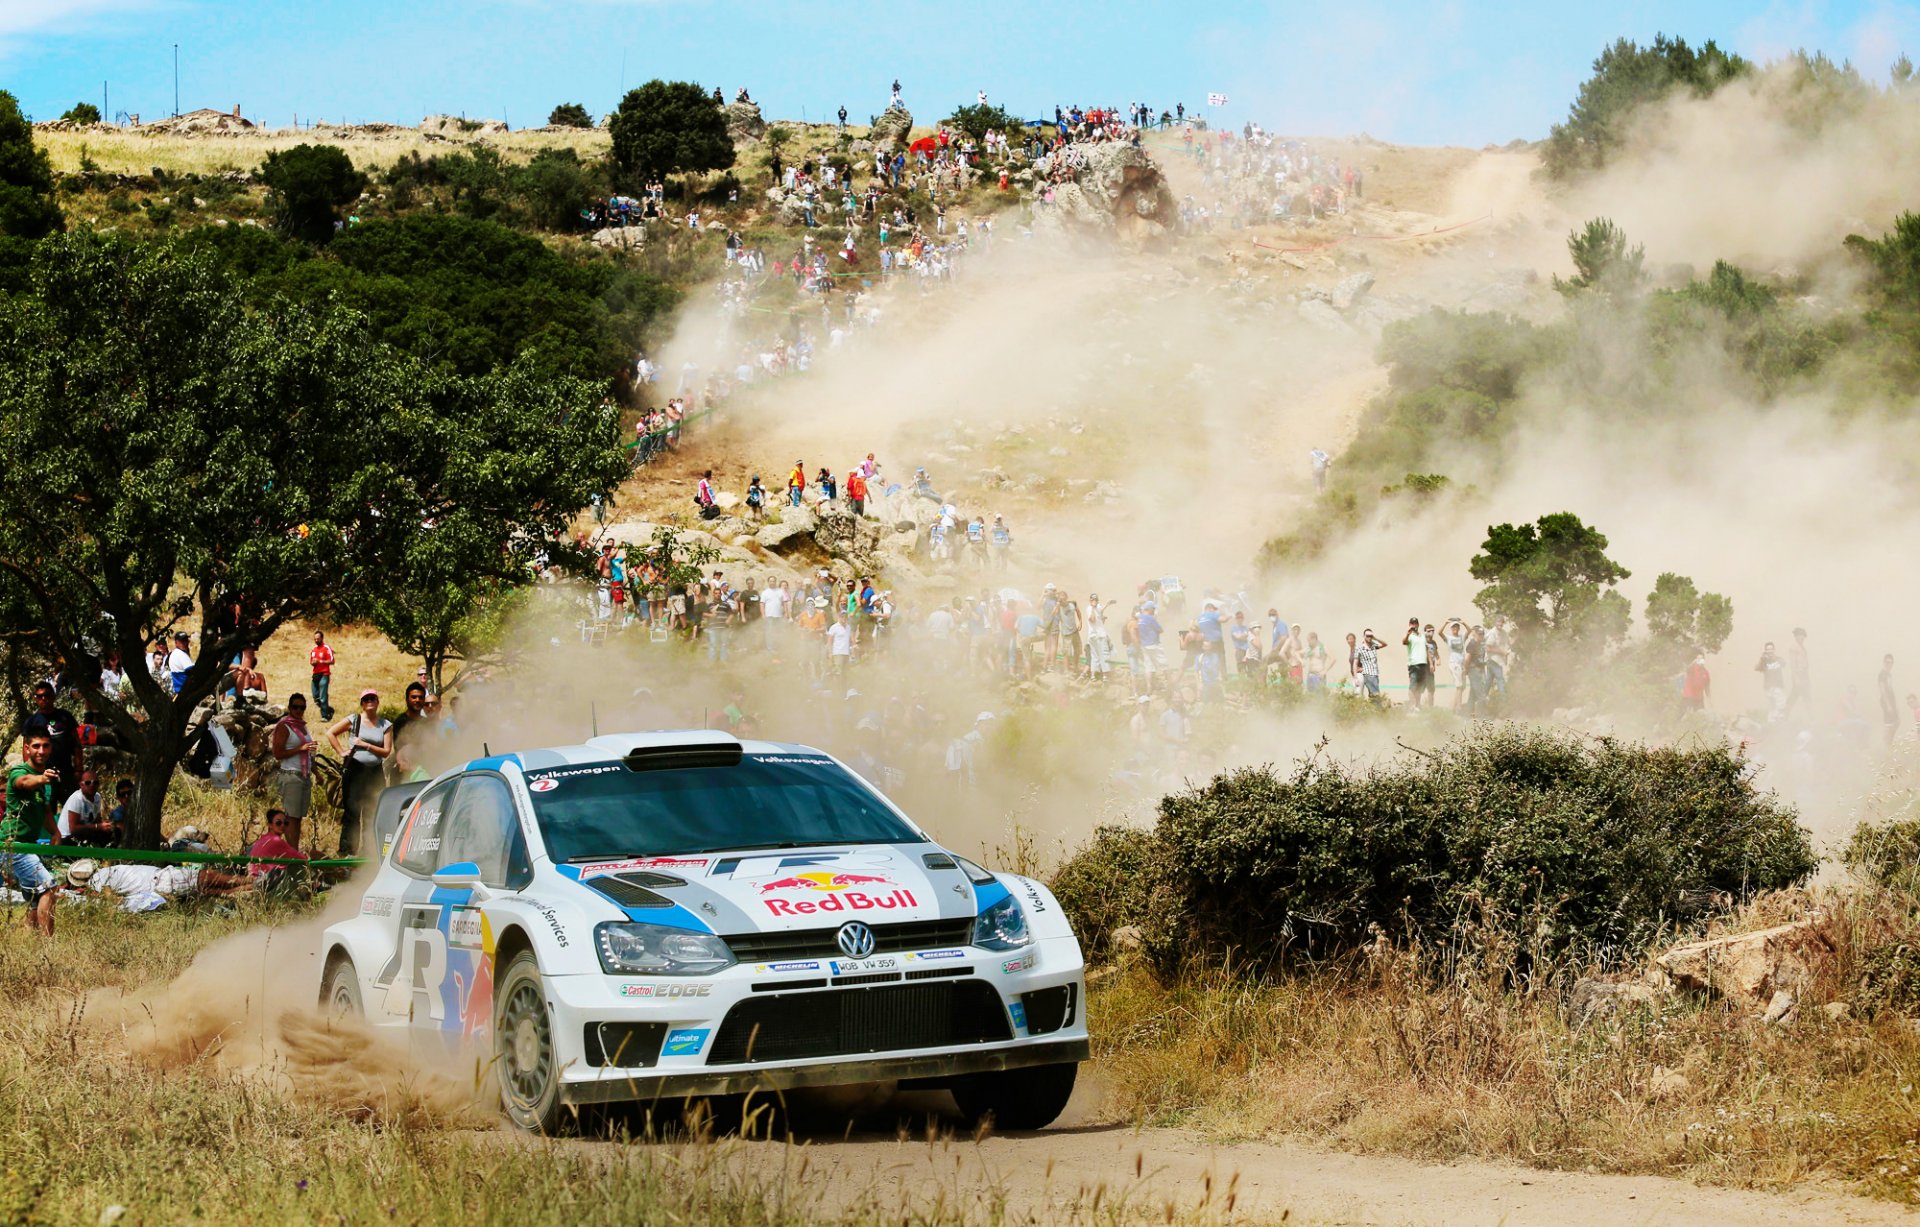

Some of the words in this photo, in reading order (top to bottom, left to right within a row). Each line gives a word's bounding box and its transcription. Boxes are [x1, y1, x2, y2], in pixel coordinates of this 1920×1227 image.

[752, 756, 834, 765] Volkswagen
[528, 765, 621, 781] Volkswagen
[535, 780, 553, 791] 2
[763, 892, 844, 917] Red
[843, 889, 918, 911] Bull
[541, 909, 569, 948] Services
[774, 962, 819, 971] MICHELIN
[838, 961, 859, 971] WOB
[863, 960, 876, 969] VW
[876, 959, 895, 968] 359
[627, 985, 653, 996] Castrol
[655, 983, 713, 998] EDGE
[668, 1034, 700, 1043] ultimate
